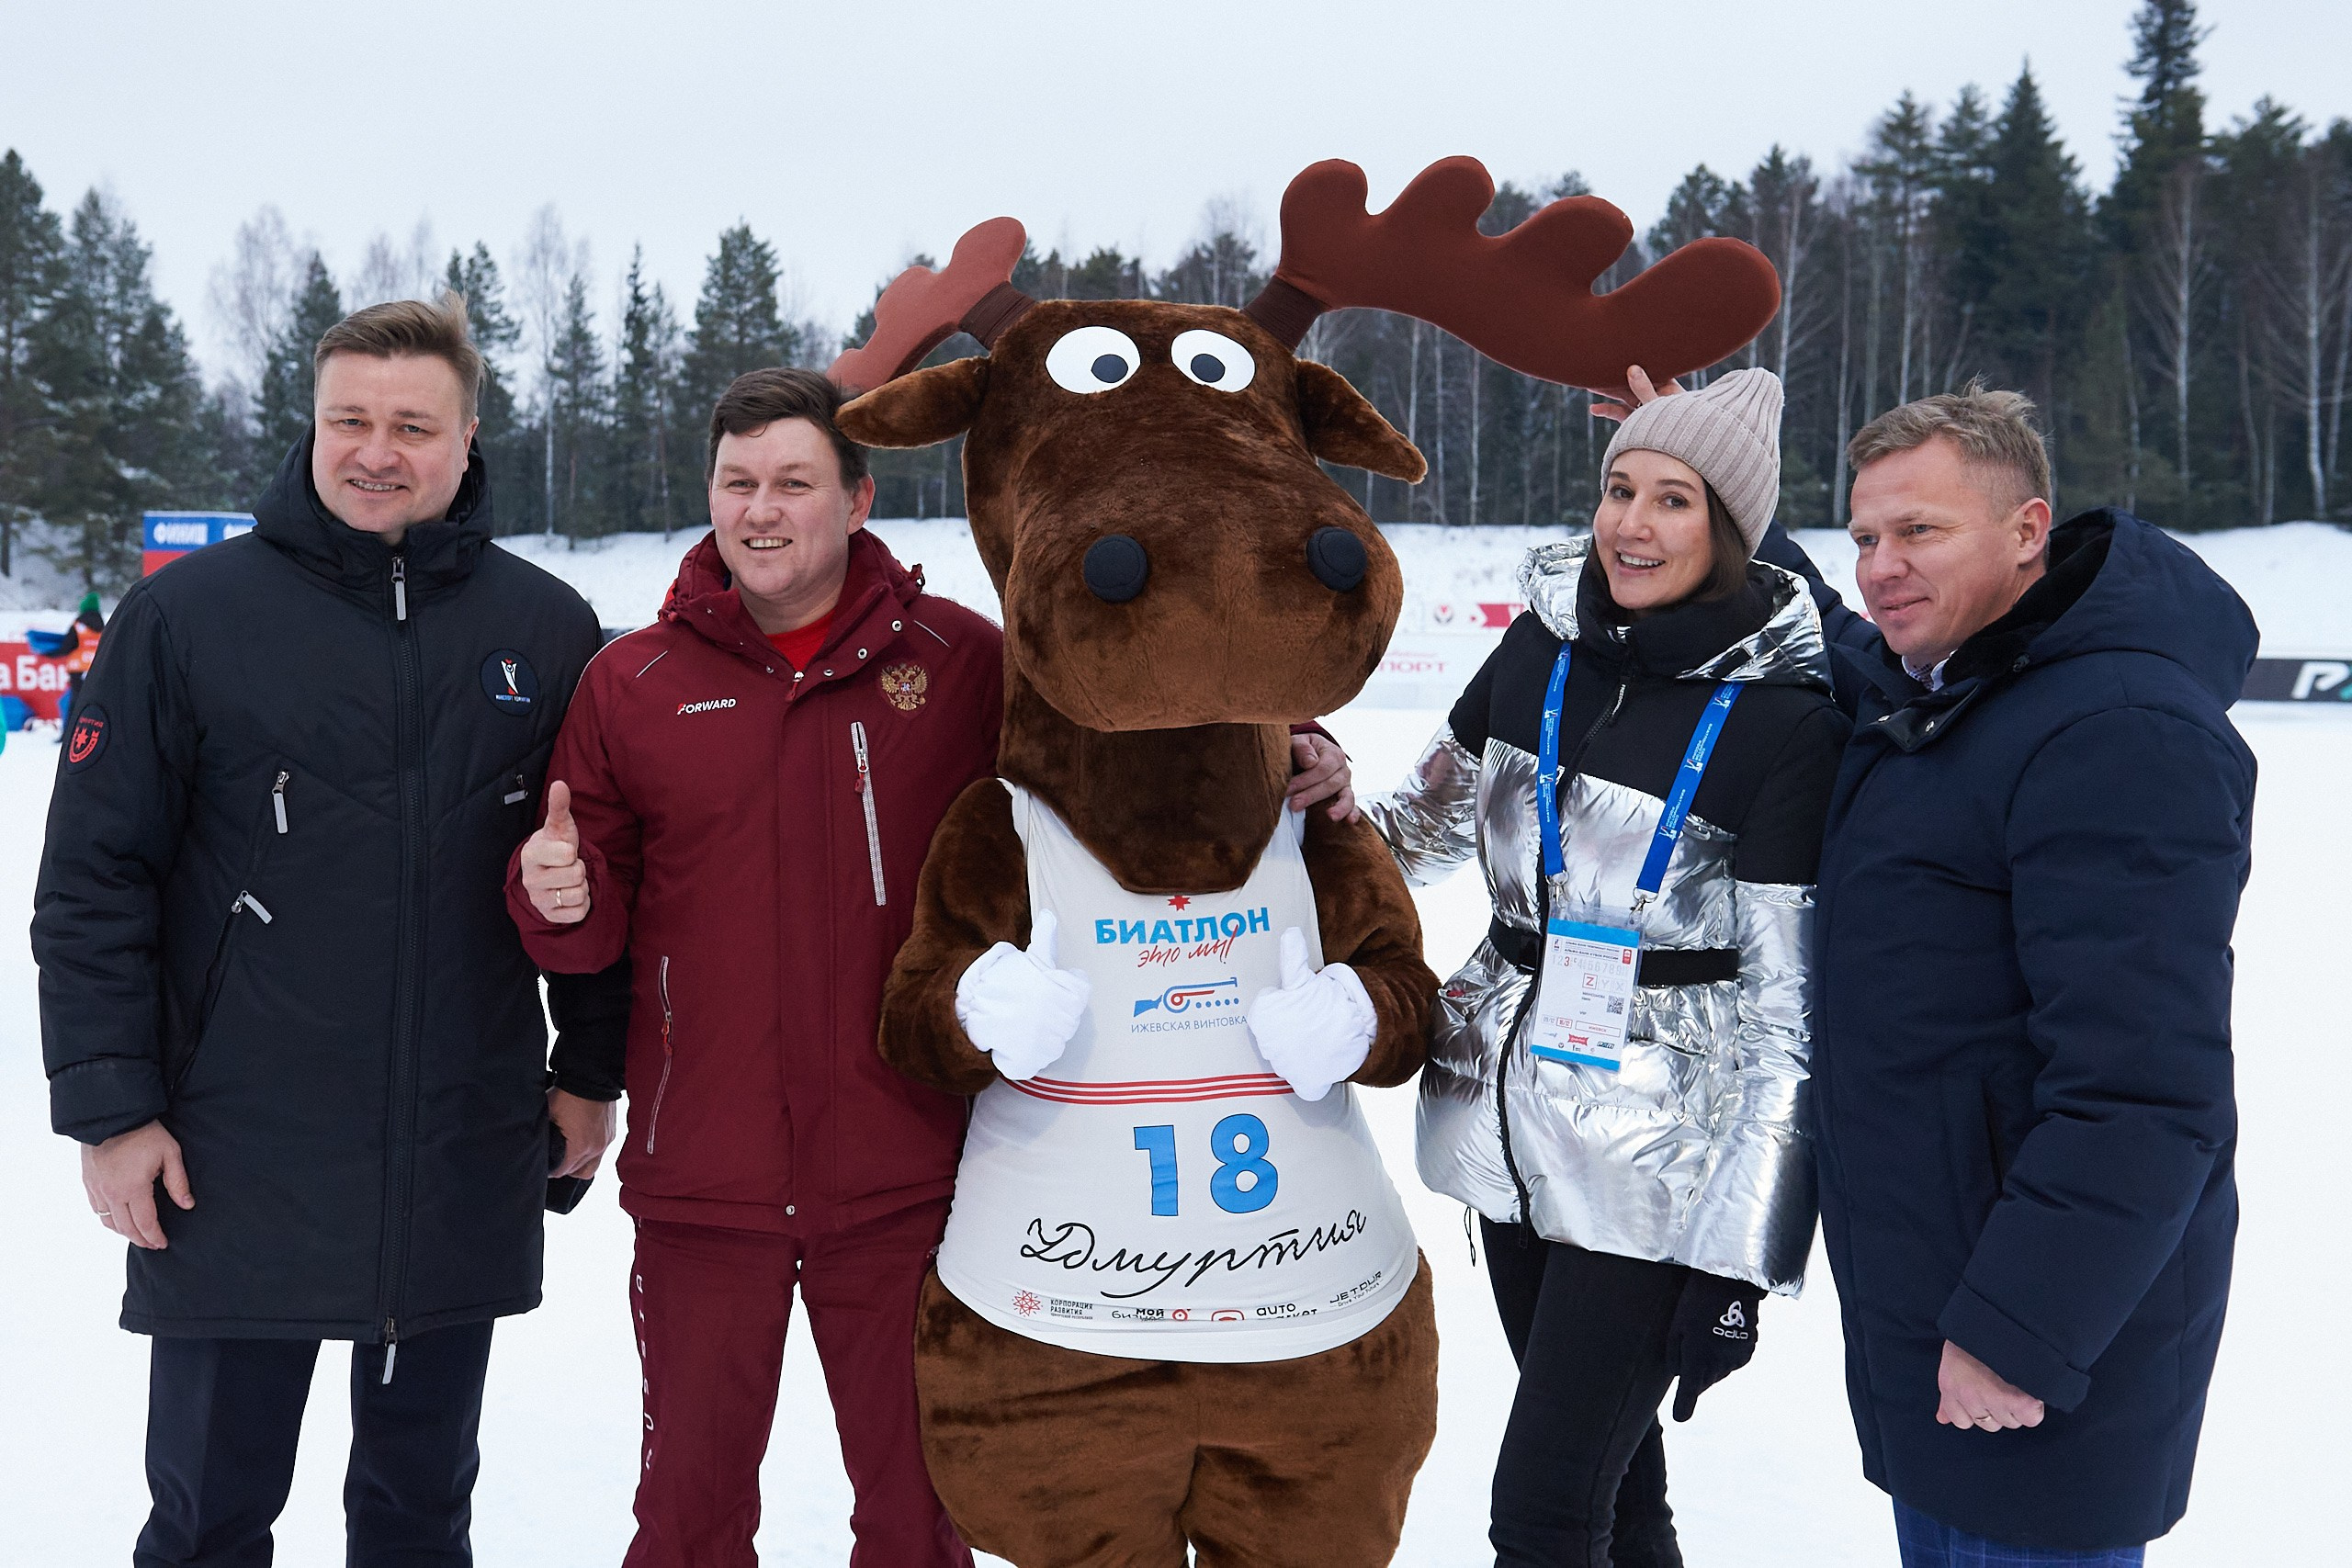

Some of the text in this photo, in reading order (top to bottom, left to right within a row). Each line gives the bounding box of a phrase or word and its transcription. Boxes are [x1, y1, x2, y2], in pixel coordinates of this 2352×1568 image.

[153, 522, 209, 546] ФИНИШ
[16, 654, 71, 691] Бан
[676, 698, 737, 715] FORWARD
[1094, 907, 1271, 945] БИАТЛОН
[1137, 945, 1181, 967] это
[1564, 956, 1570, 967] 3
[1586, 976, 1594, 987] Z
[1131, 1015, 1248, 1033] ИЖЕВСКАЯ ВИНТОВКА
[1133, 1113, 1278, 1216] 18
[1021, 1209, 1367, 1298] Удмуртия
[1329, 1270, 1382, 1303] JETOUR
[1050, 1299, 1093, 1310] КОРПОРАЦИЯ
[1050, 1306, 1083, 1315] РАЗВИТИЯ
[1713, 1326, 1749, 1339] odlo
